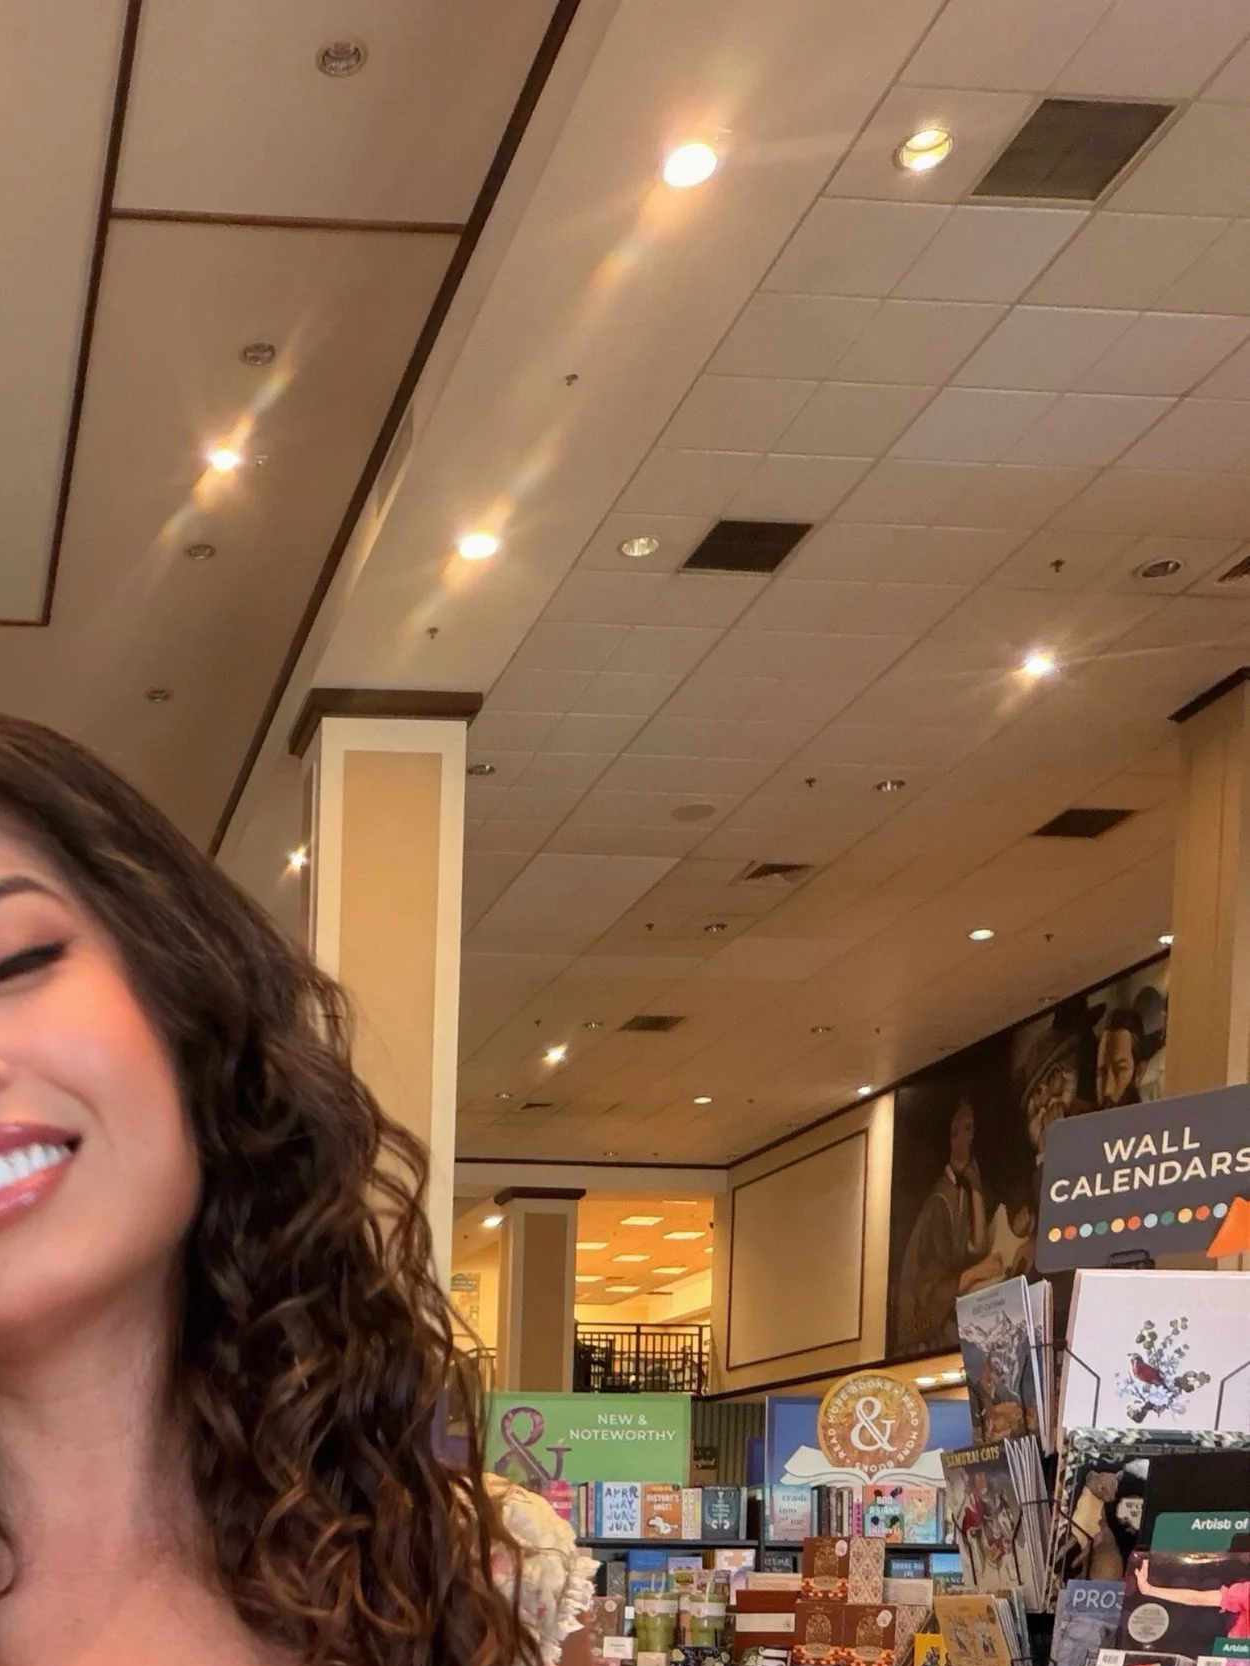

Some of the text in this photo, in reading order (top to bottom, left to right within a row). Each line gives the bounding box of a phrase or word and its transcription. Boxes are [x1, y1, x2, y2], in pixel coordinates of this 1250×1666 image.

[1103, 1126, 1201, 1164] WALL
[1050, 1147, 1250, 1203] CALENDARS
[598, 1414, 648, 1426] NEW &
[569, 1429, 677, 1441] NOTEWORTHY
[945, 1446, 1000, 1467] SAMURAI CATS
[609, 1521, 635, 1531] JULY
[1191, 1518, 1250, 1530] Artist of
[1223, 1643, 1250, 1653] Artist
